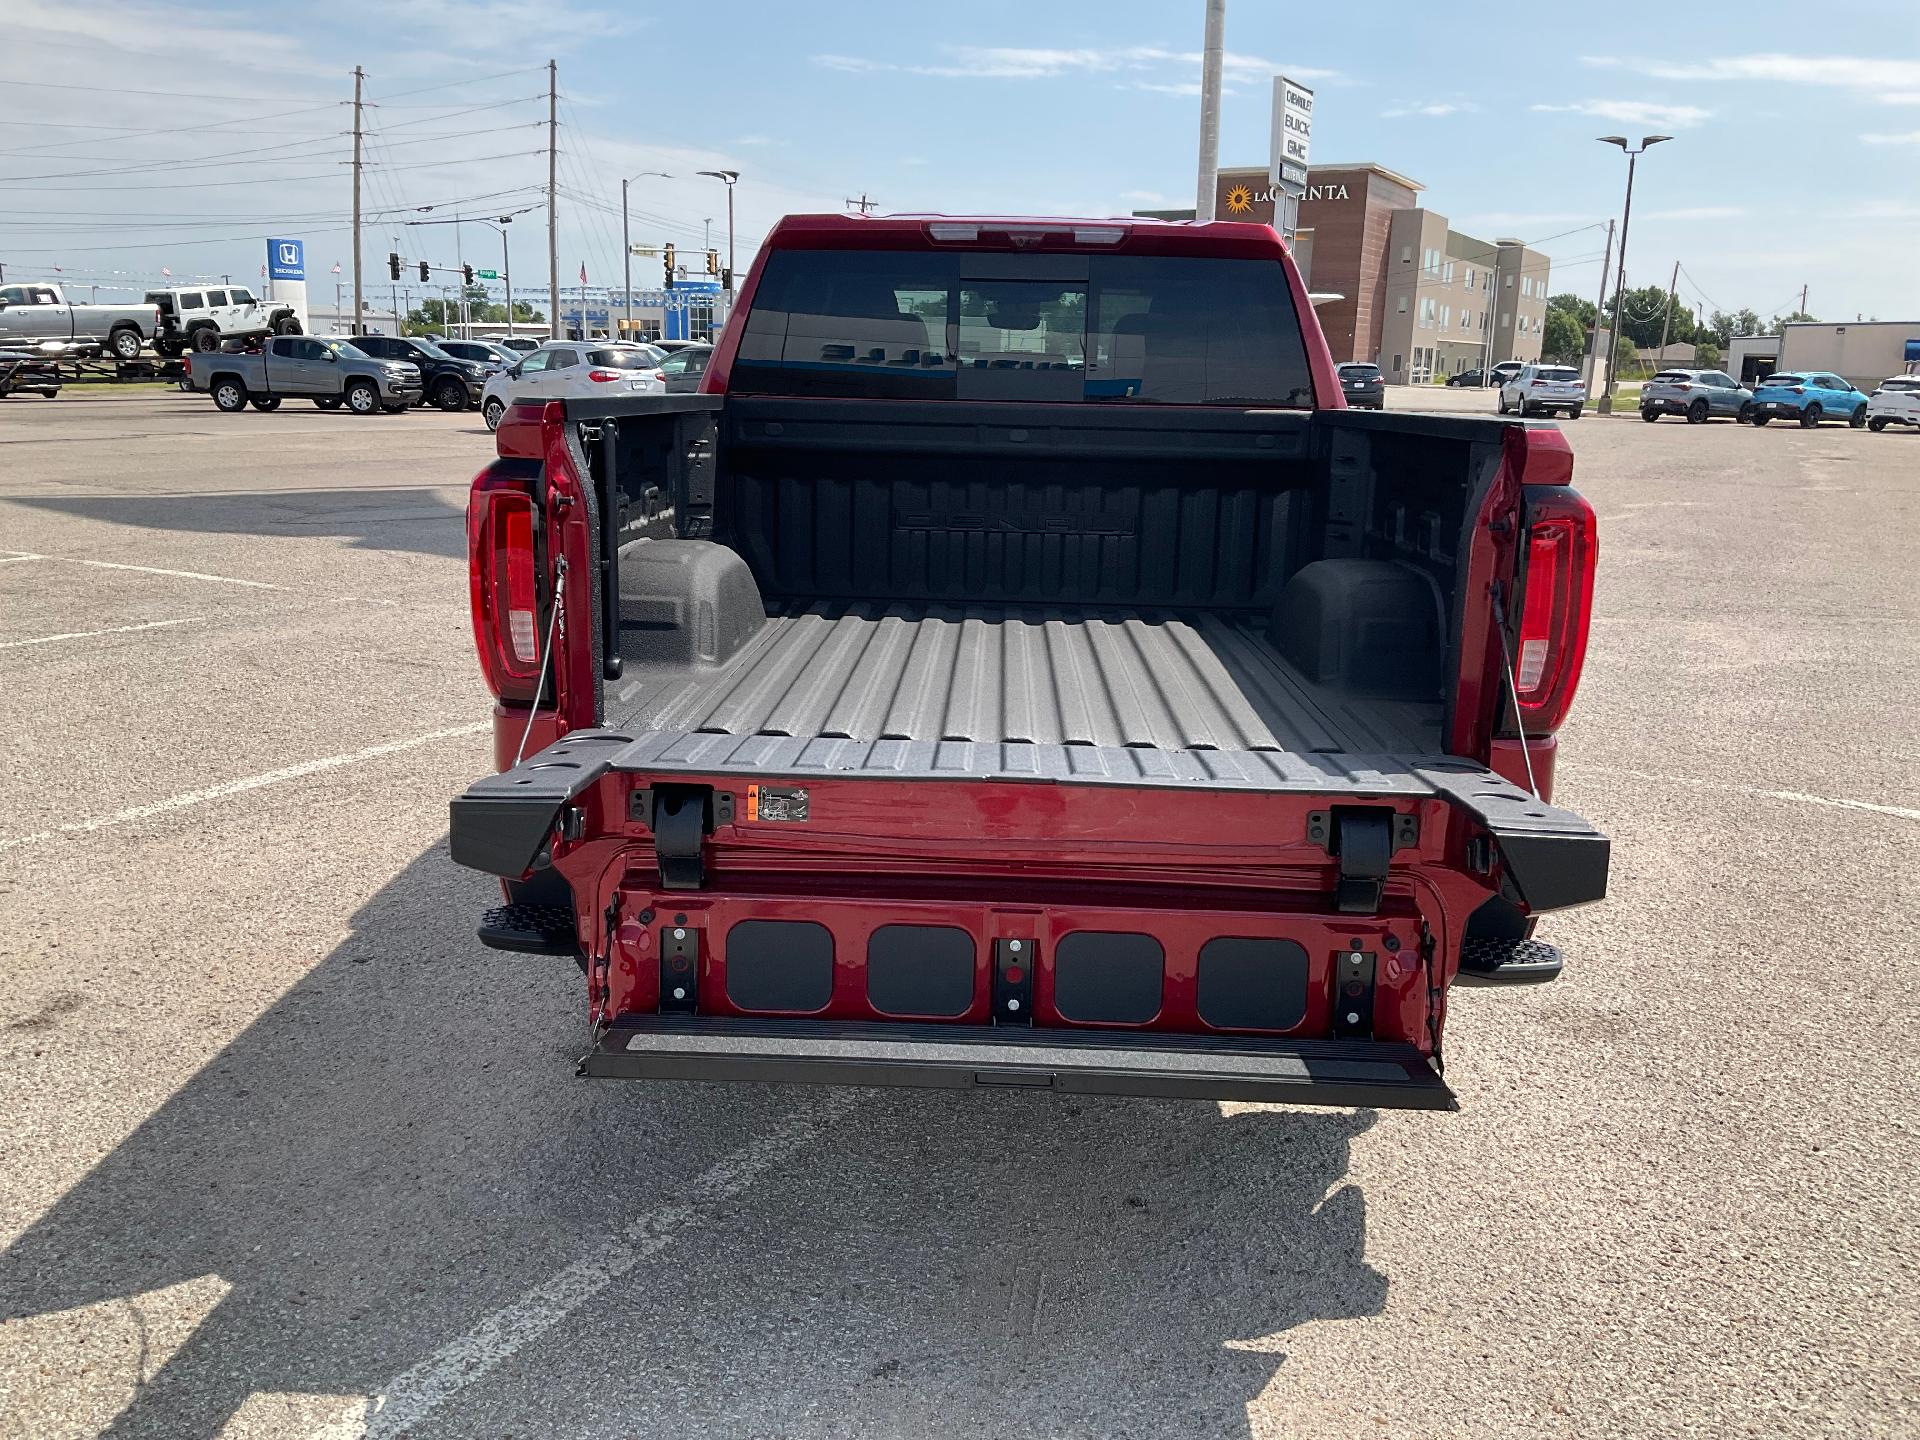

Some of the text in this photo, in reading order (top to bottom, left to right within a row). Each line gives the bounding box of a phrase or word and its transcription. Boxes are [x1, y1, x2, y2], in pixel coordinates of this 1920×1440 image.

[1286, 90, 1312, 111] CHEVROLET
[1285, 113, 1310, 137] BUICK
[1287, 139, 1306, 159] GMC
[1254, 185, 1349, 202] LA INTA
[274, 267, 304, 275] HONDA
